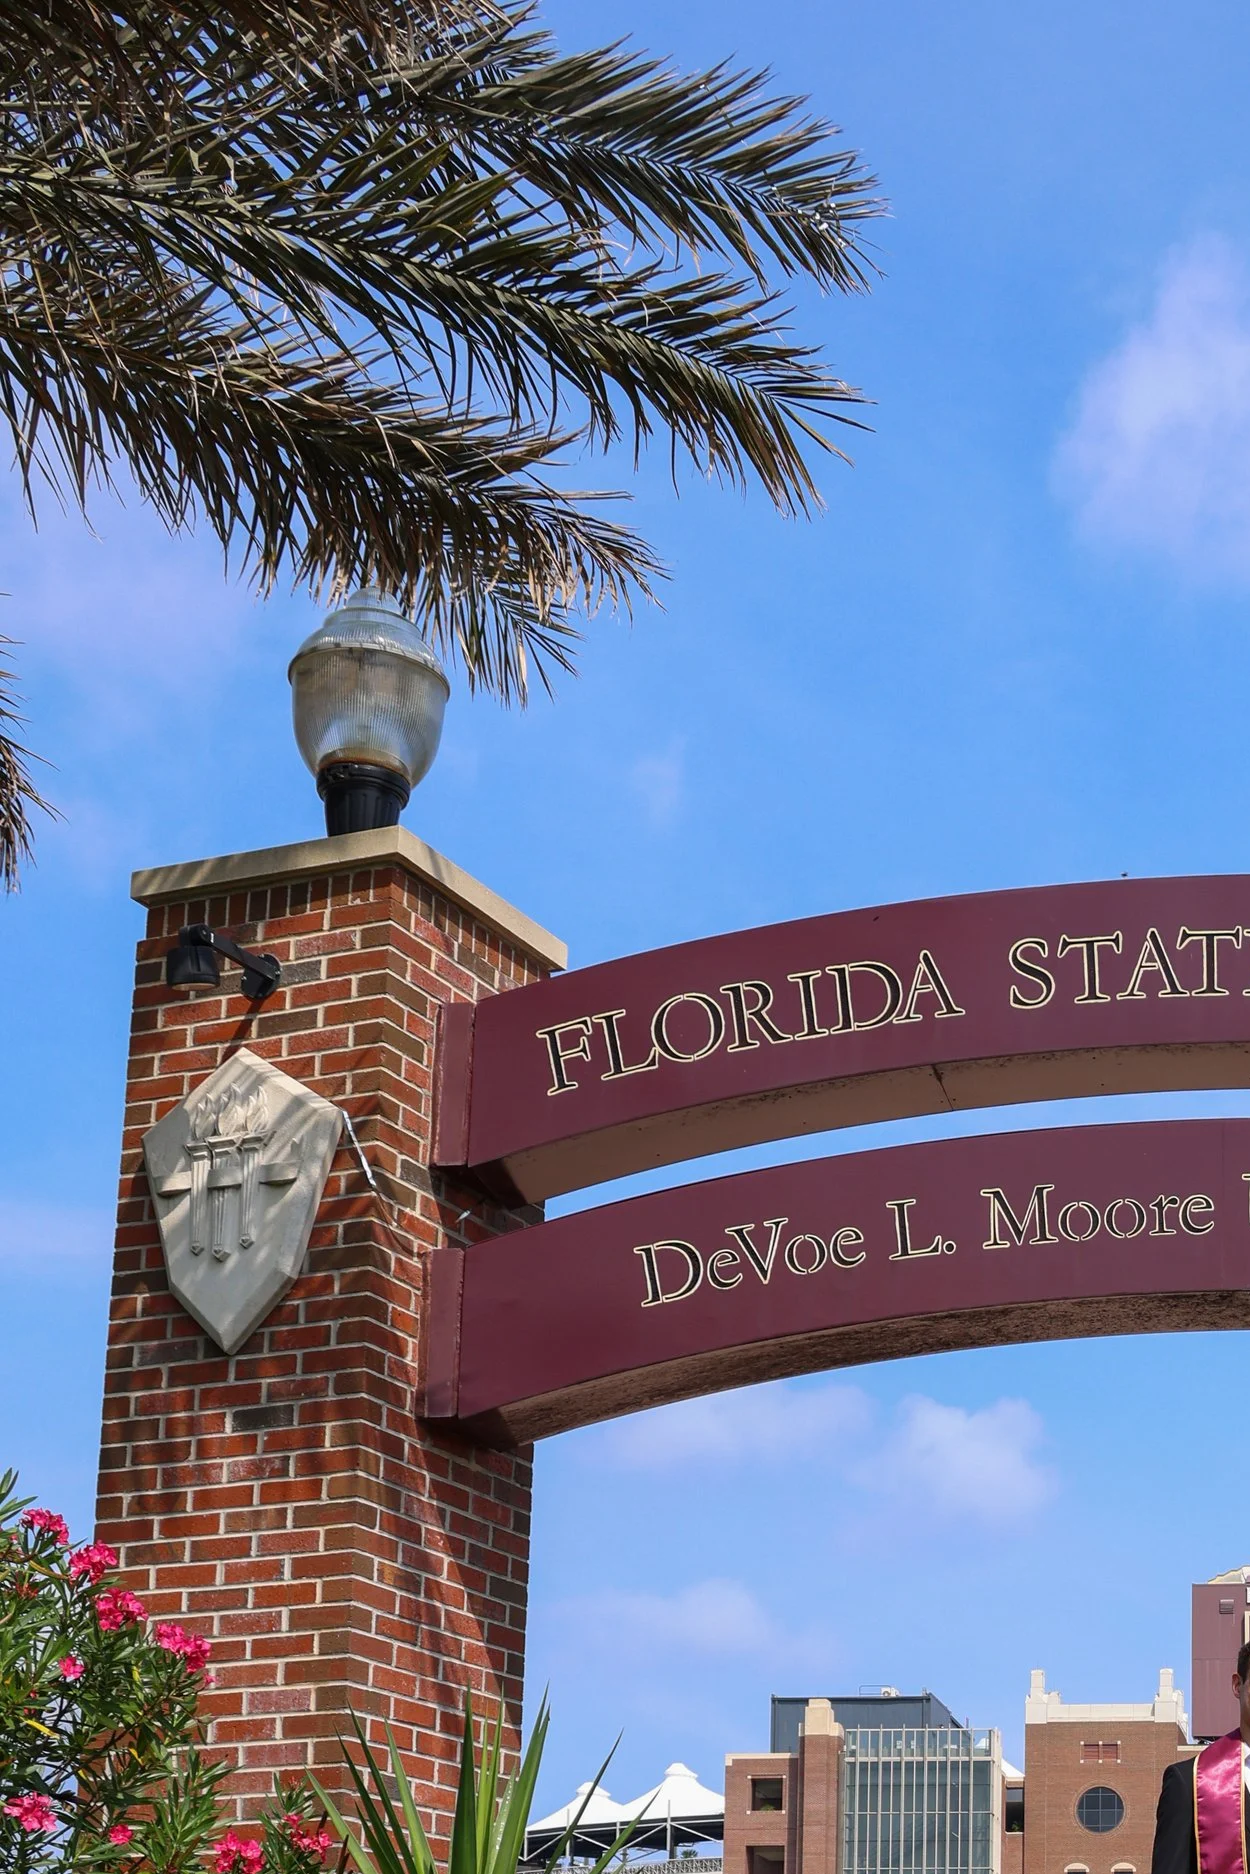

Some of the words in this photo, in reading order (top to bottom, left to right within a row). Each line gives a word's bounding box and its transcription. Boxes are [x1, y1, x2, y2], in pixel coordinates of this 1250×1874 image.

[536, 949, 966, 1096] FLORIDA
[633, 1215, 867, 1308] DeVoe
[886, 1198, 956, 1262] L.
[980, 1183, 1216, 1250] Moore
